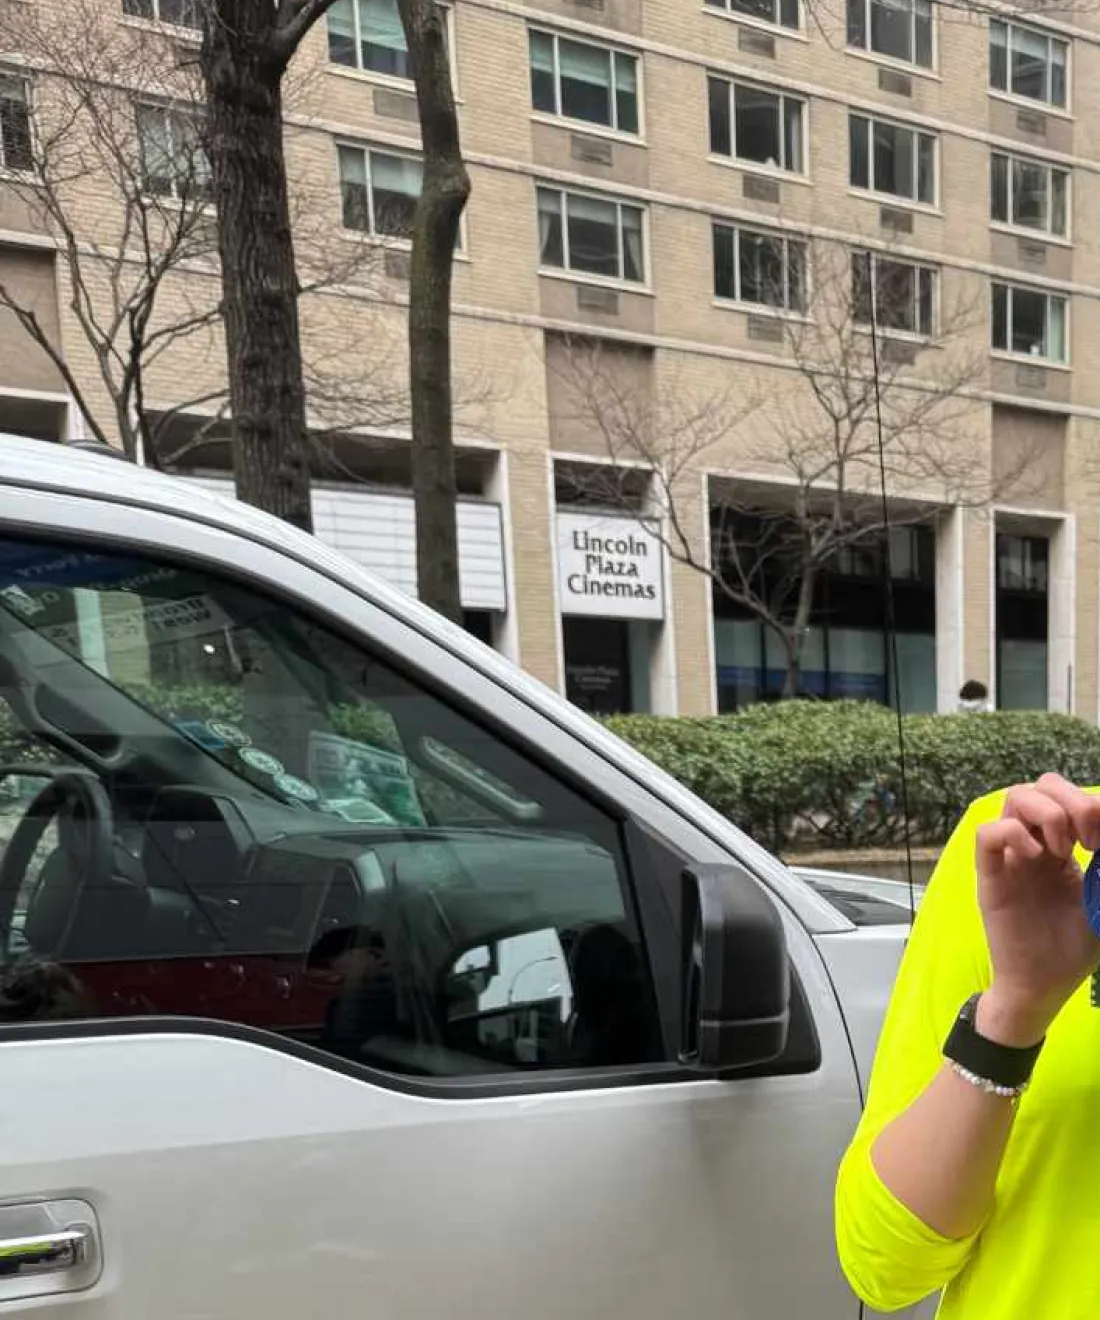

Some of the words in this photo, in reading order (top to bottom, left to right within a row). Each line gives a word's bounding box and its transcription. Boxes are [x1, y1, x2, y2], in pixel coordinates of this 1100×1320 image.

[573, 530, 648, 556] Lincoln
[585, 553, 639, 577] Plaza
[567, 574, 656, 599] Cinemas
